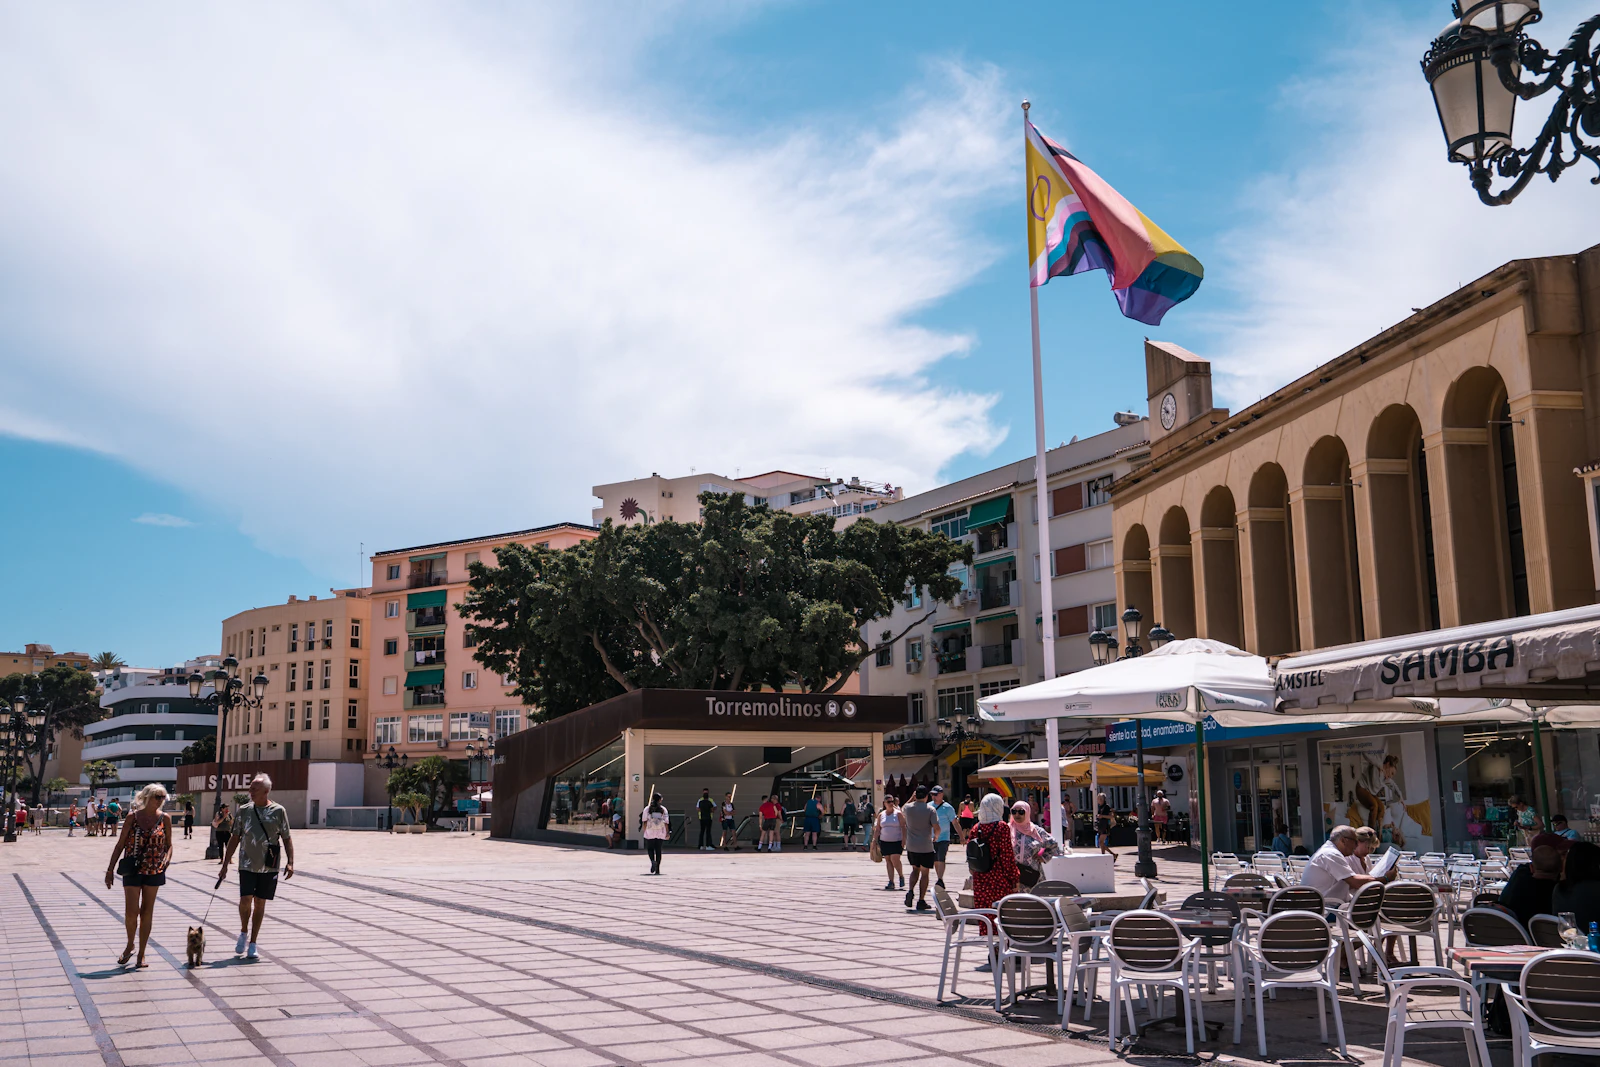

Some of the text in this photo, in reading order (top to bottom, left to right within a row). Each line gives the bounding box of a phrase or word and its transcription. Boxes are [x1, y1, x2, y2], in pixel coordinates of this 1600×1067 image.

[1381, 635, 1514, 684] SAMBA
[1276, 669, 1324, 691] AMSTEL
[705, 696, 822, 717] Torremolinos
[1109, 731, 1124, 742] siente
[1124, 728, 1130, 740] la
[1130, 725, 1152, 739] cadad,
[1153, 723, 1184, 737] enamórate
[1202, 717, 1216, 731] ecio
